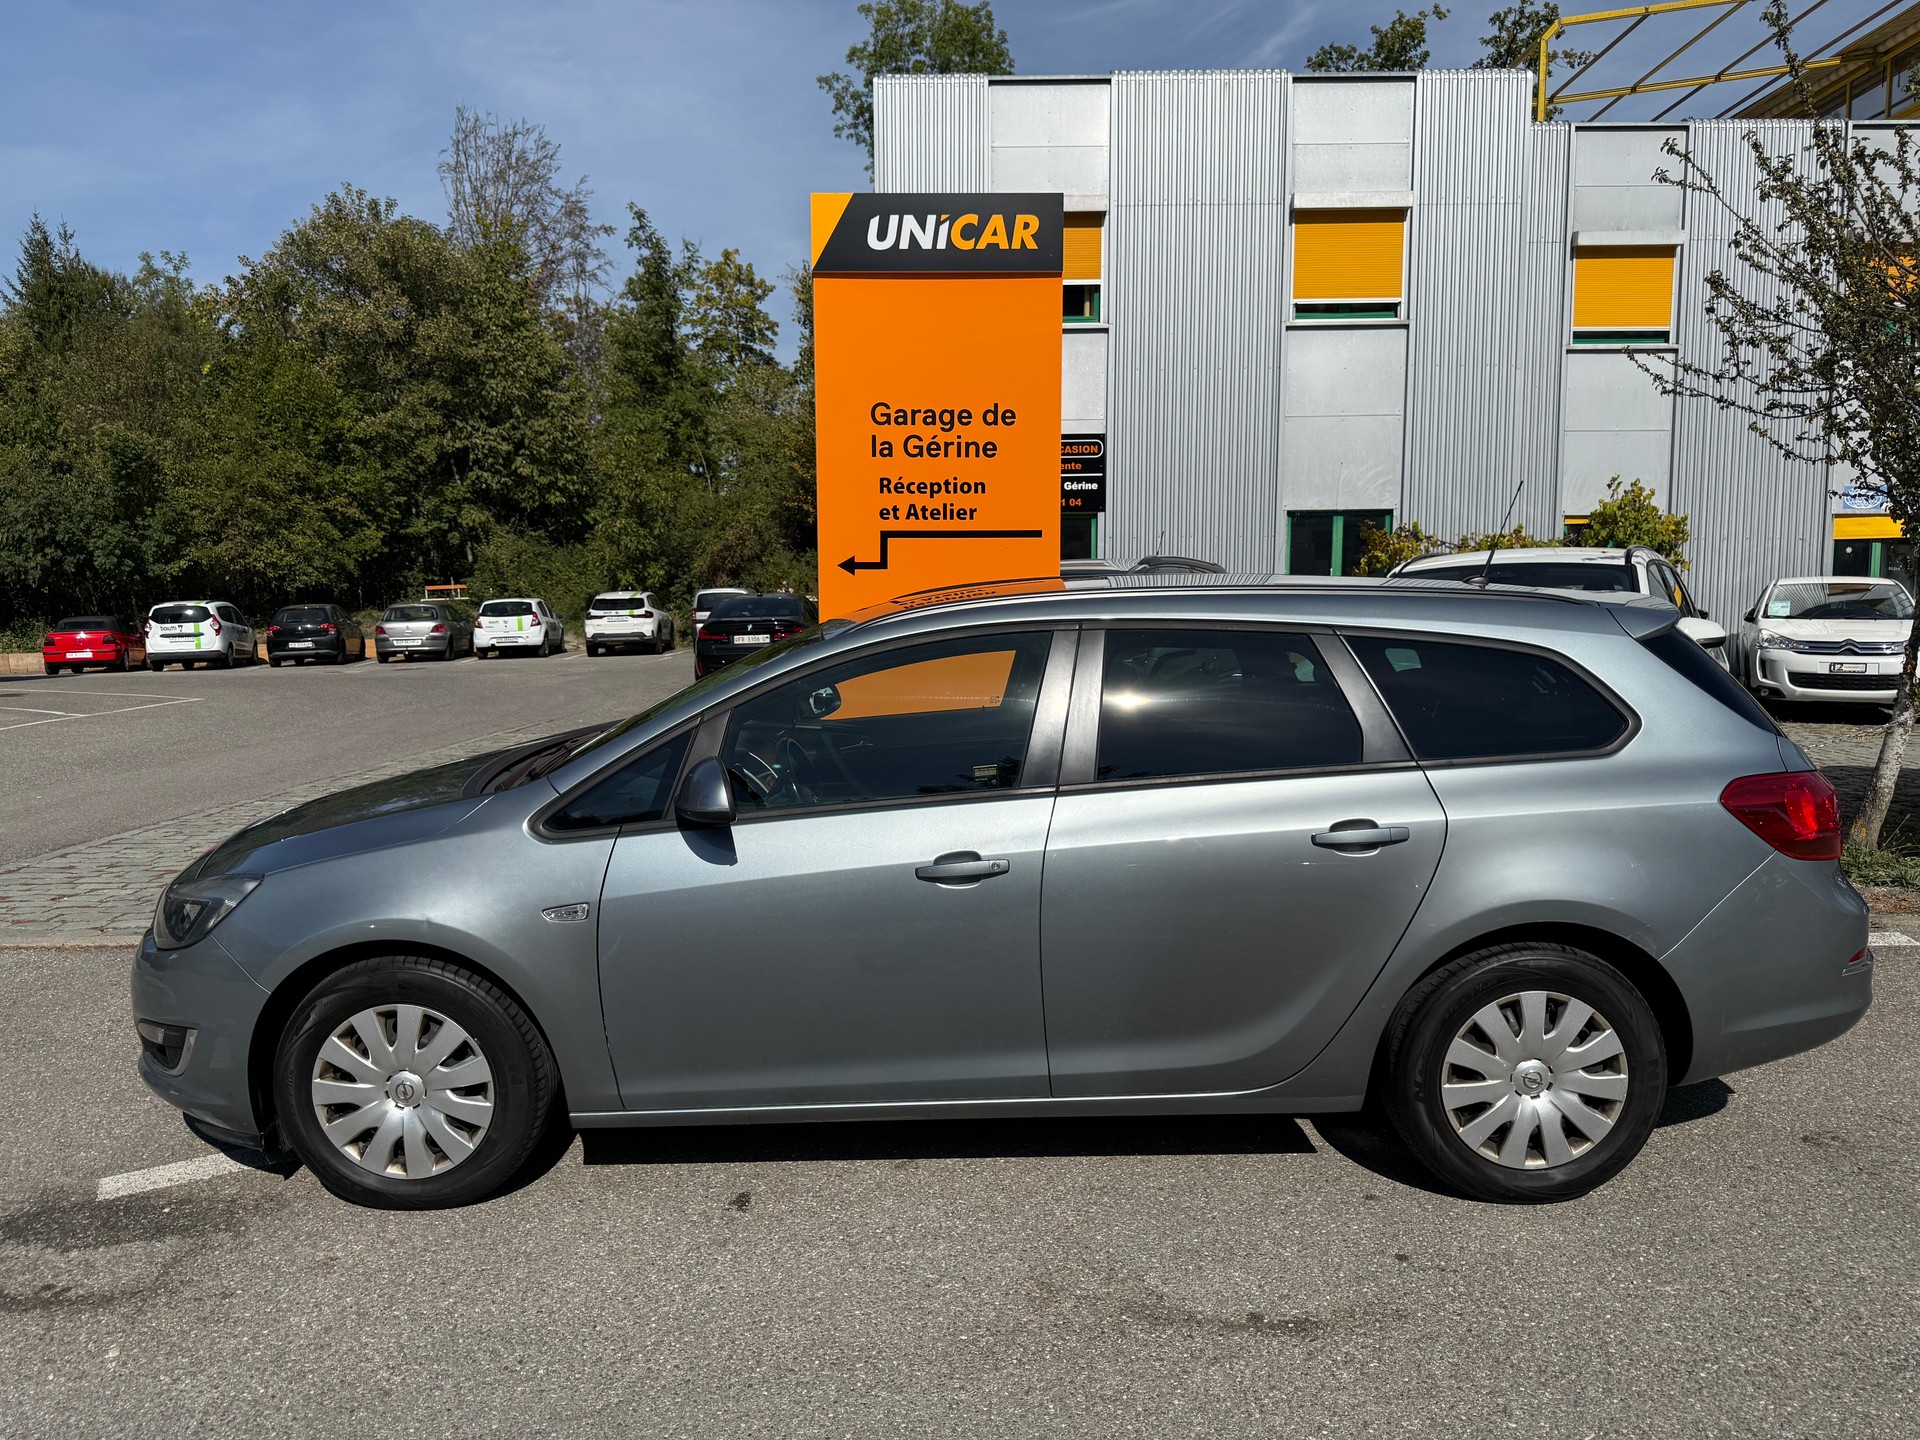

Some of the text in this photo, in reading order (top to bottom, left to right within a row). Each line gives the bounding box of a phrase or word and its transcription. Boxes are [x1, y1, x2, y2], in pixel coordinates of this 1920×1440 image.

[870, 402, 1017, 433] Garage de
[871, 434, 998, 459] la Gérine
[879, 476, 986, 498] Réception
[1063, 481, 1099, 491] Gérine
[879, 502, 978, 521] et Atelier
[1069, 498, 1082, 507] 04
